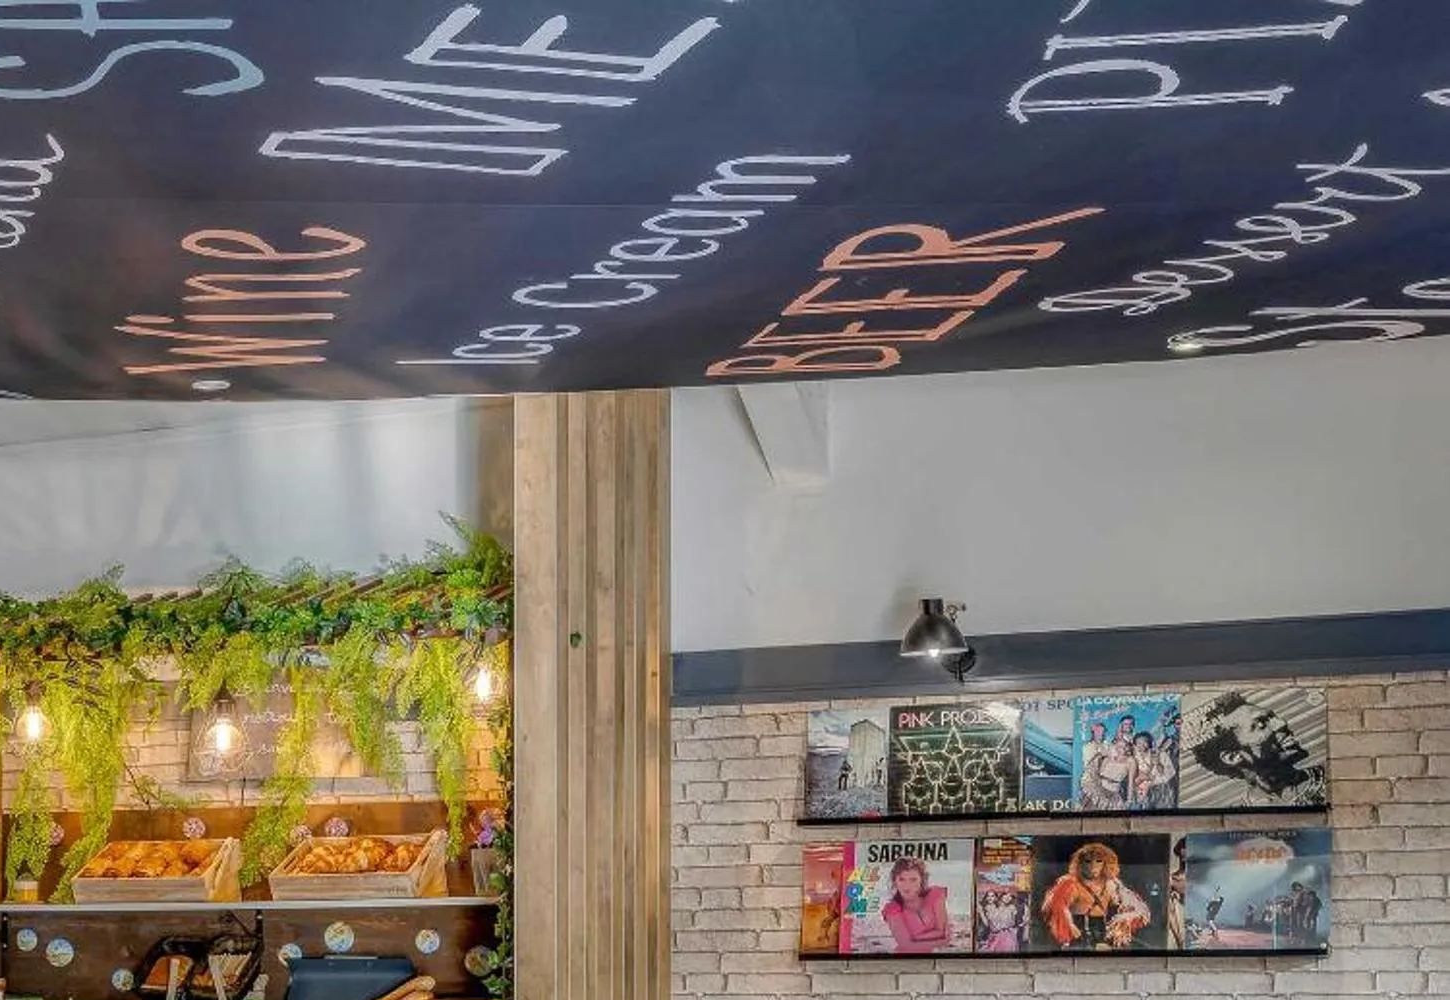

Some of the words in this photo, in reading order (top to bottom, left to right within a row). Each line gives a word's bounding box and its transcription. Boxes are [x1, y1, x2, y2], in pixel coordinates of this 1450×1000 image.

[259, 0, 730, 177] ME
[1007, 0, 1350, 123] PI
[113, 226, 367, 375] Wine
[705, 207, 1107, 377] BEER
[898, 711, 935, 728] PINK
[867, 842, 948, 863] SABRINA
